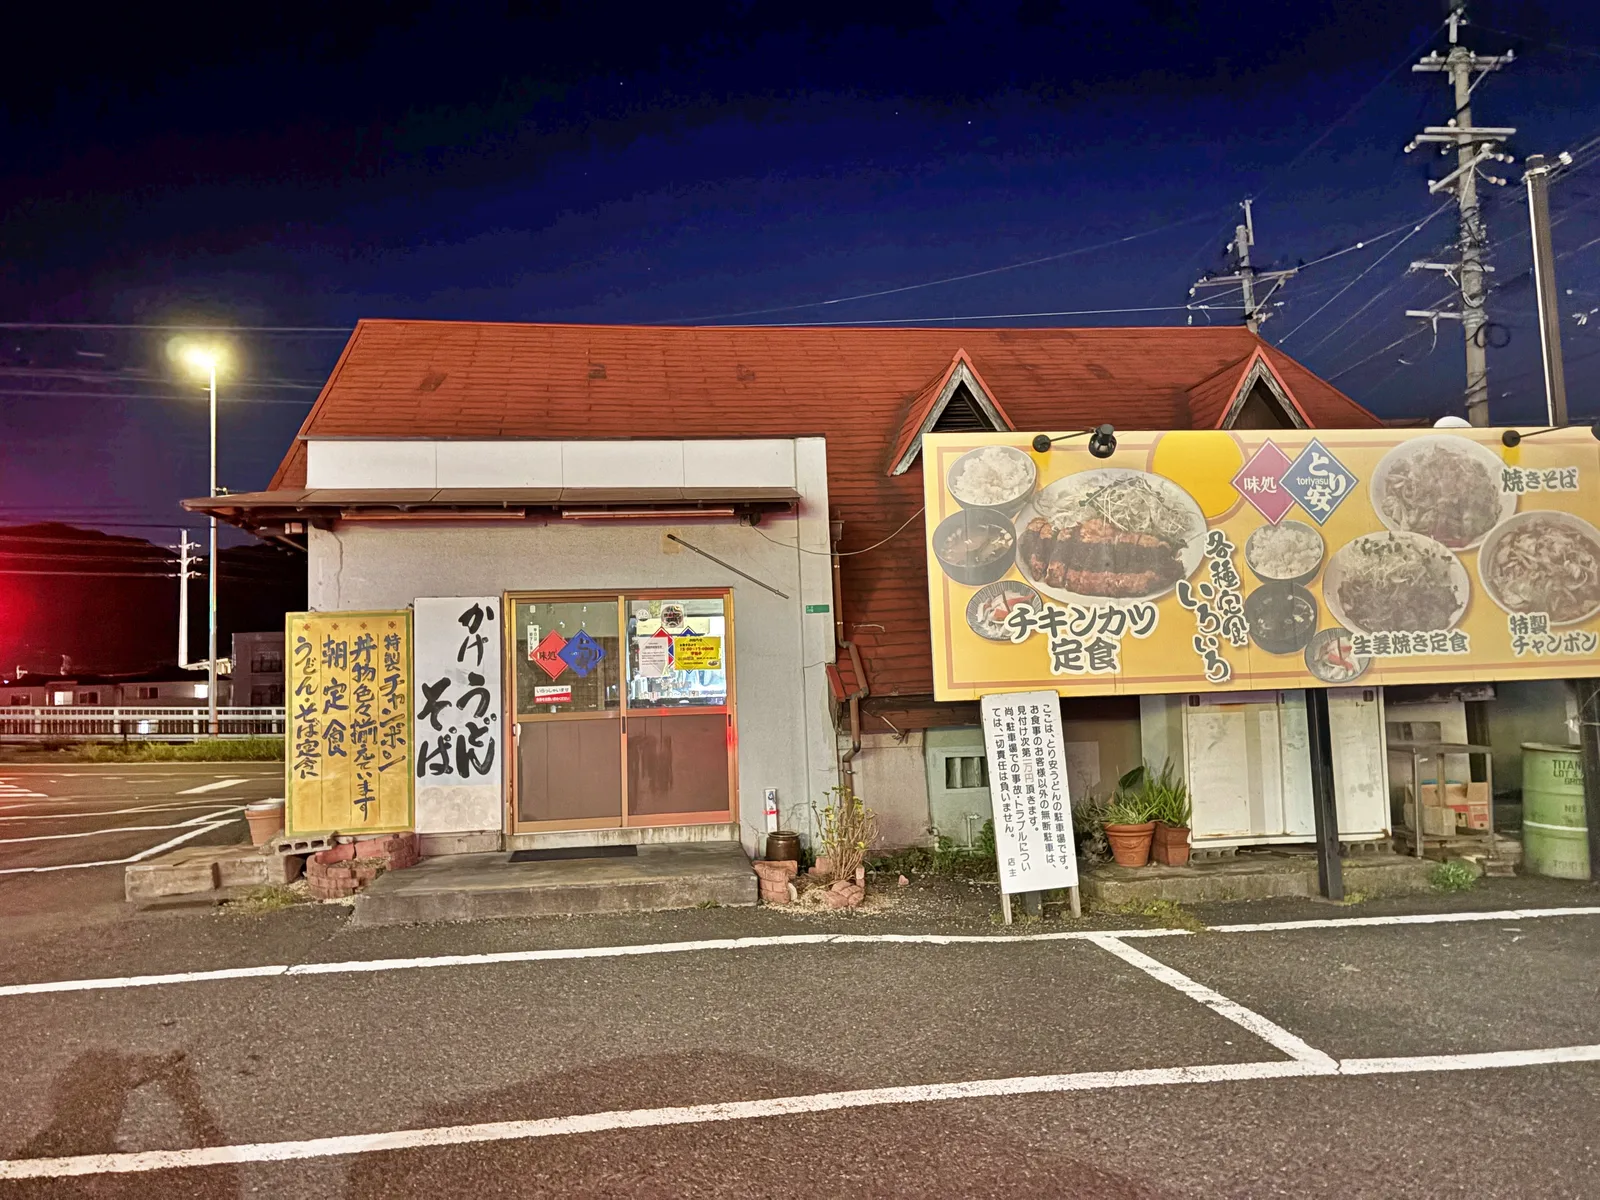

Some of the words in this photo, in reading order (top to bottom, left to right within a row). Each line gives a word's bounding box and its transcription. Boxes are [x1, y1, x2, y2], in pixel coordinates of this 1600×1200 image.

[1244, 476, 1277, 494] 味処
[1296, 476, 1328, 487] toriyasu
[1304, 452, 1346, 512] とり安
[1502, 468, 1577, 493] 焼きそば
[1008, 604, 1156, 638] チキンカツ
[1206, 531, 1248, 644] 各種定食
[1509, 614, 1548, 635] 特製
[537, 648, 557, 661] 味処
[1052, 638, 1117, 671] 定食
[1178, 581, 1229, 681] いろいろ
[1353, 632, 1468, 654] 生姜焼き定食
[1512, 632, 1597, 655] チャンポン
[294, 635, 321, 779] うどん・そば定食
[322, 634, 349, 757] 朝定食
[350, 633, 378, 821] 丼物色々揃えています
[417, 677, 458, 778] そば
[456, 602, 497, 778] かけうどん
[992, 708, 1015, 838] ては、一切責任は負いません。
[1004, 707, 1031, 872] 尚、駐車場での事故・トラブルについ
[1030, 705, 1057, 869] お食事のお客様以外の無断駐車は、
[1043, 704, 1069, 870] ここは、とり安うどんの駐車場です。
[1008, 858, 1017, 877] 店主
